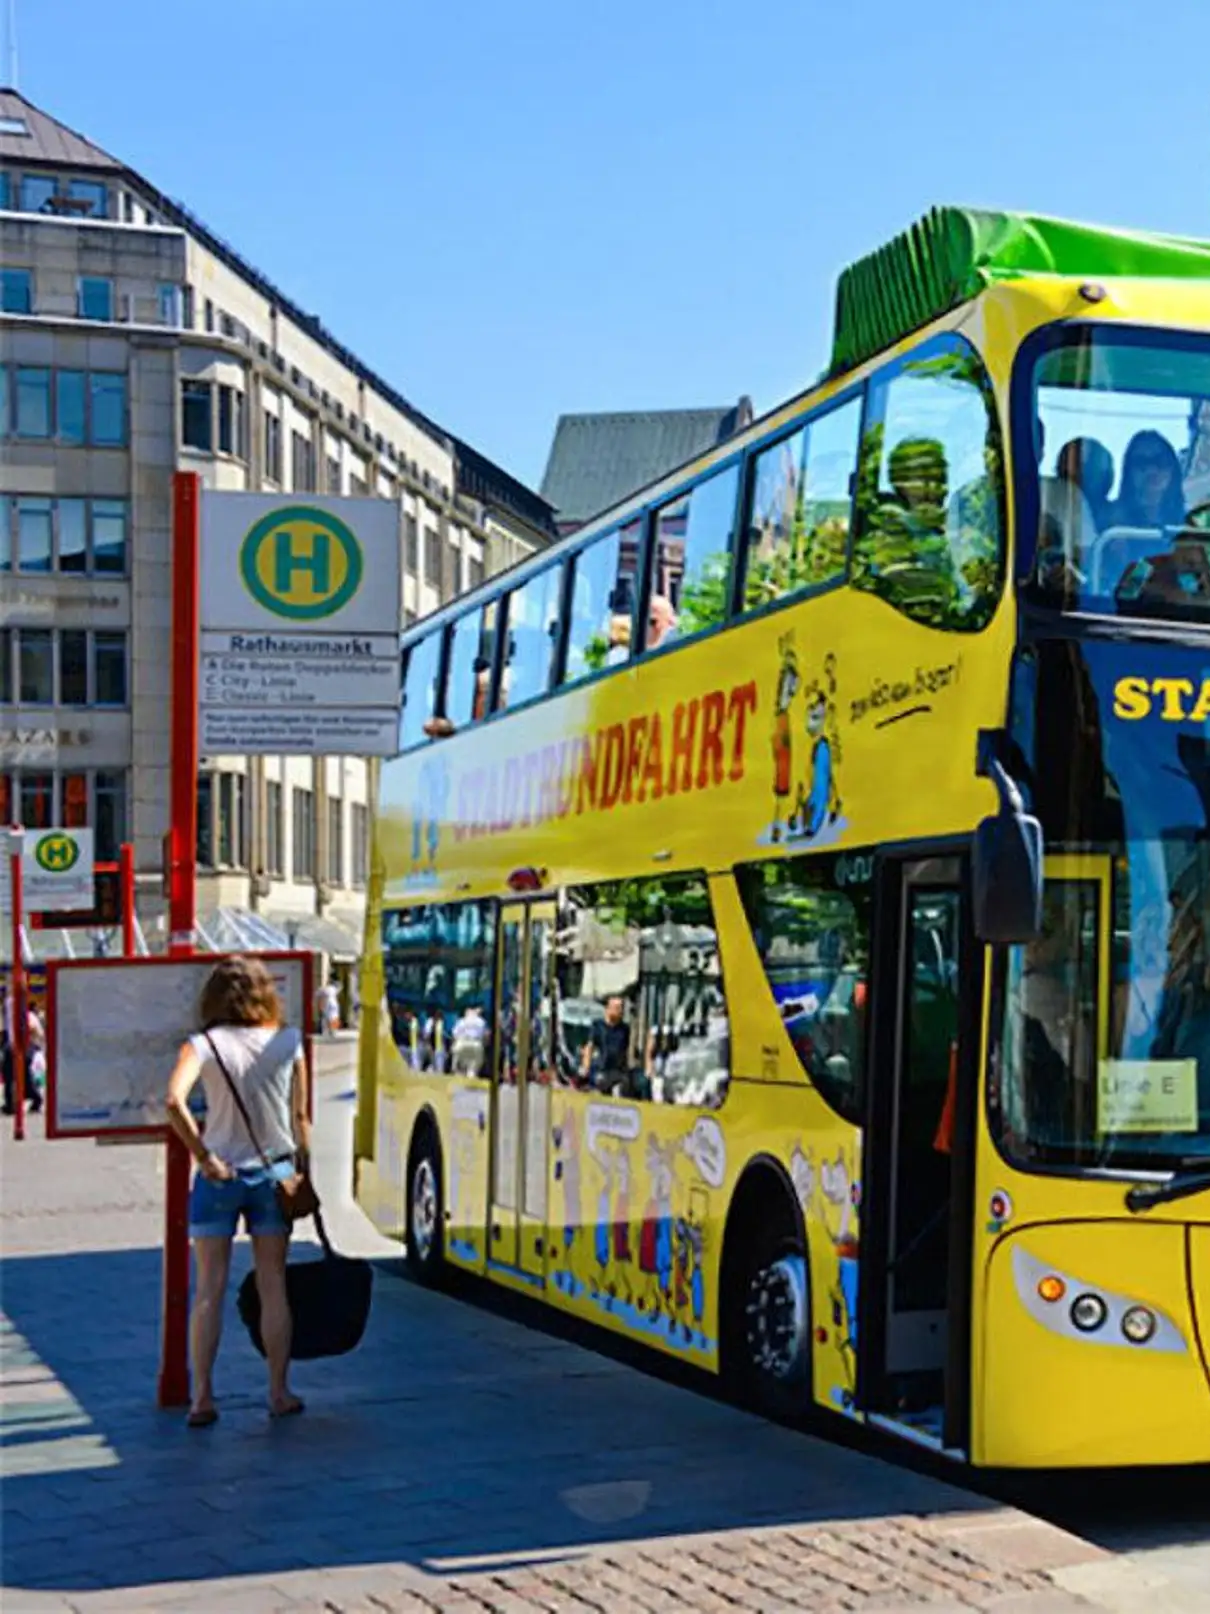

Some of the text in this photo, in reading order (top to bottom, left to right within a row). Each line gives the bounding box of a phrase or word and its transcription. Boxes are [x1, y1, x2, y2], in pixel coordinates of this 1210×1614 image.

[230, 635, 372, 656] Rathausmarkt
[222, 675, 249, 688] City
[452, 679, 758, 842] STADTRUNDFAHRT
[1161, 1076, 1174, 1094] E
